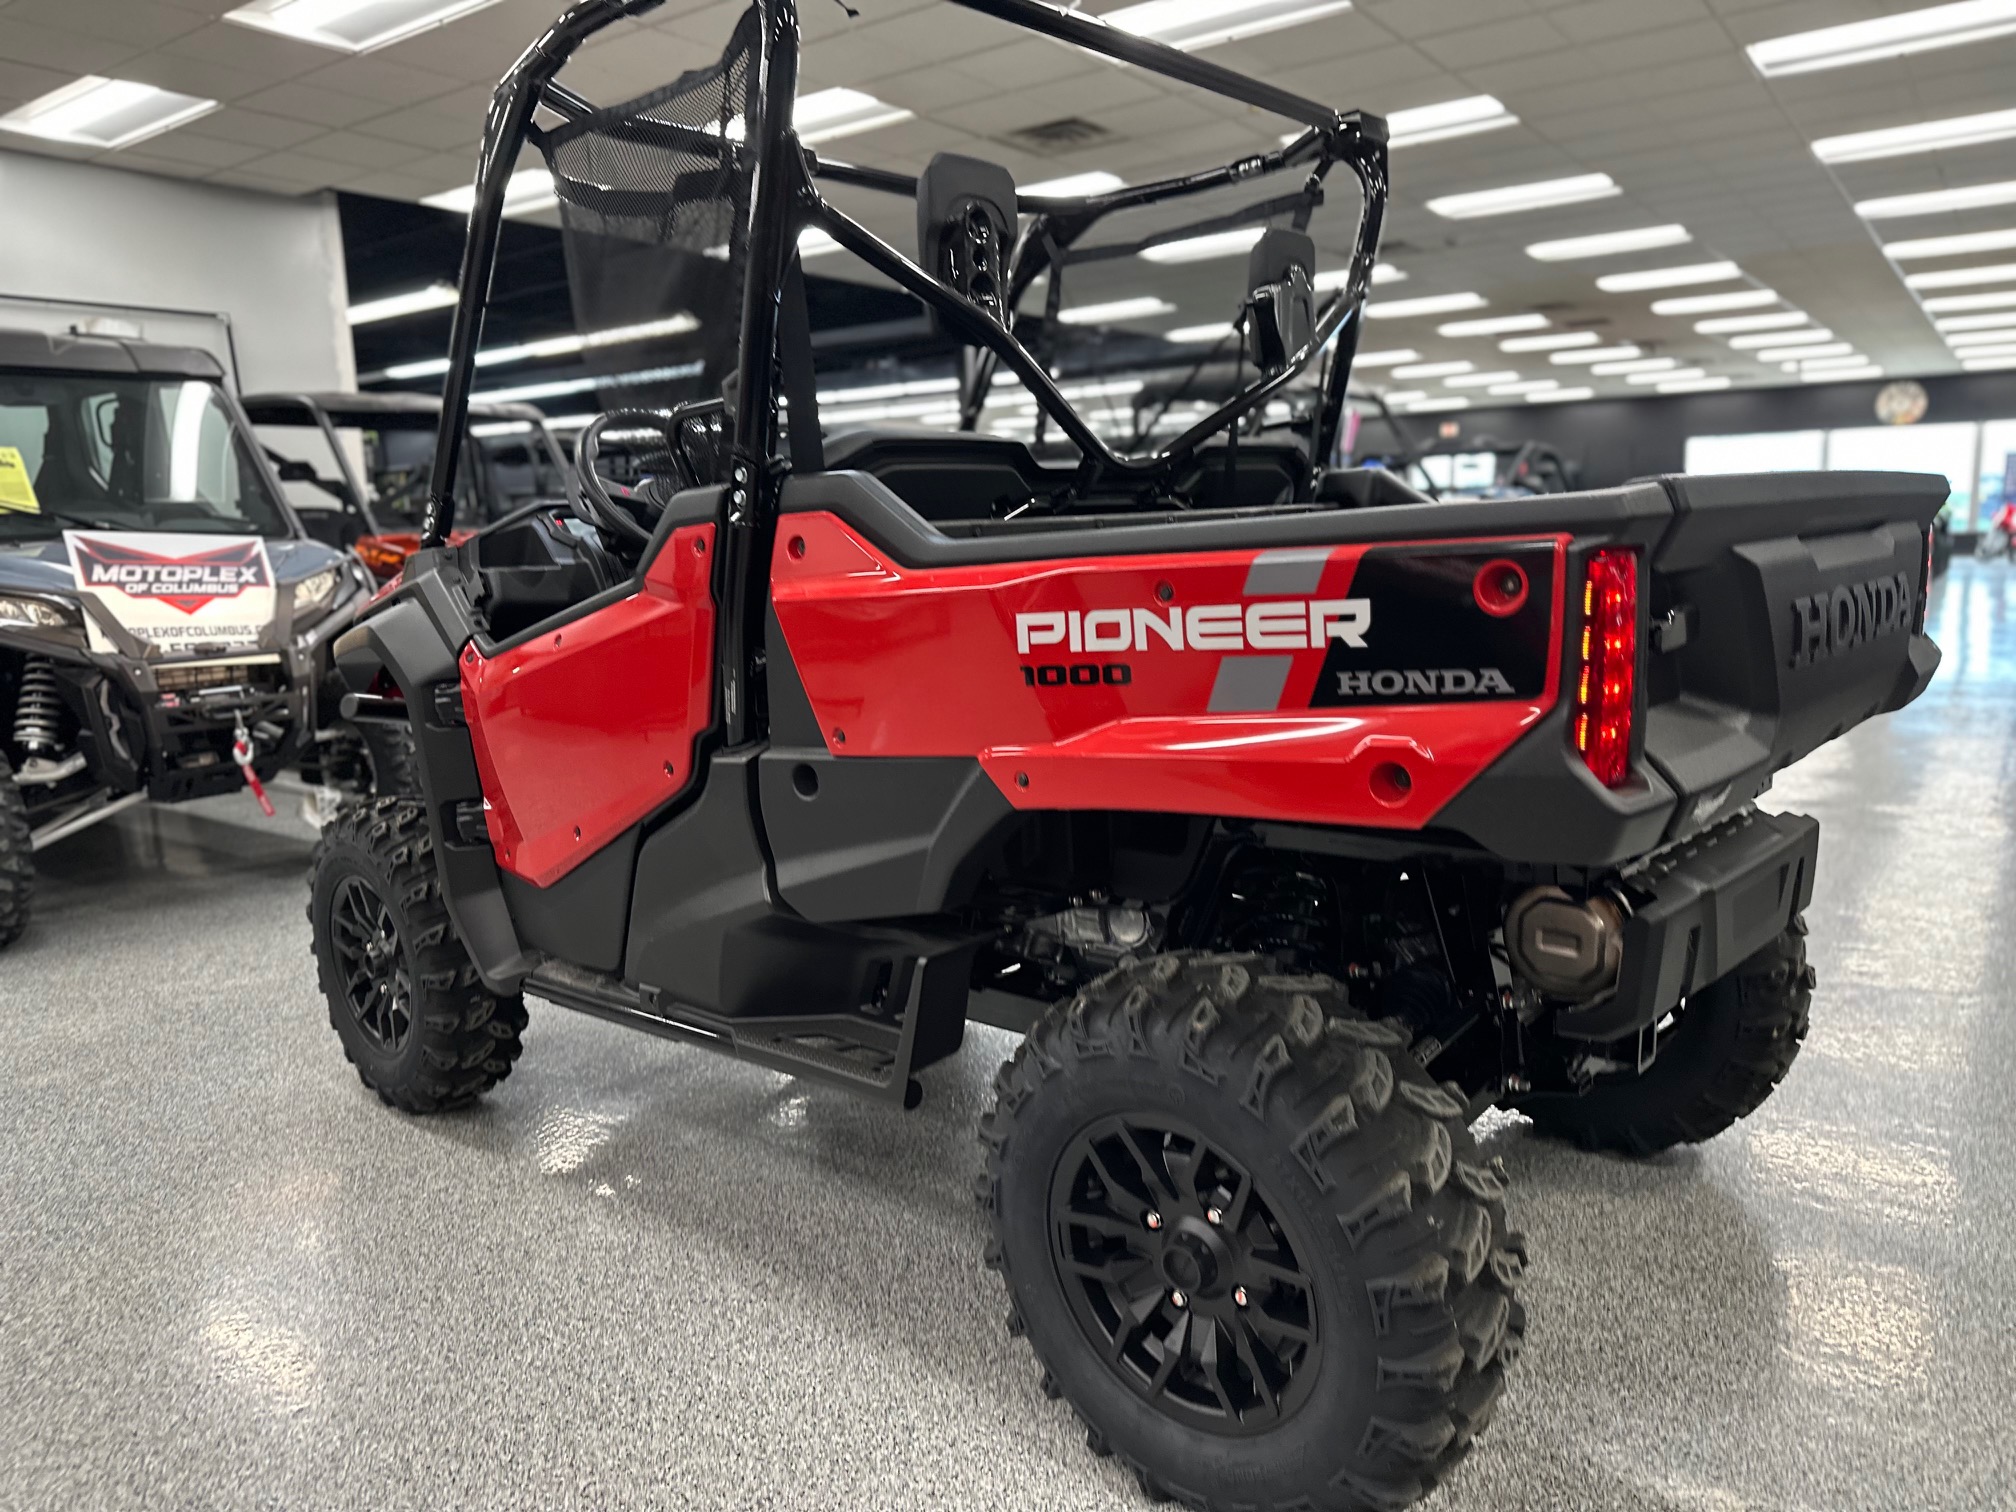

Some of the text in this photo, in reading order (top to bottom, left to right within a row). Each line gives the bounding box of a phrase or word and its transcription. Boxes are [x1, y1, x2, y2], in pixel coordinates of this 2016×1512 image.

[91, 563, 259, 584] MOTOPLEX
[124, 583, 239, 595] OF COLUMBUS
[1016, 598, 1371, 655] PIONEER
[1792, 570, 1912, 667] HONDA
[1020, 663, 1132, 688] 1000
[1335, 668, 1515, 697] HONDA
